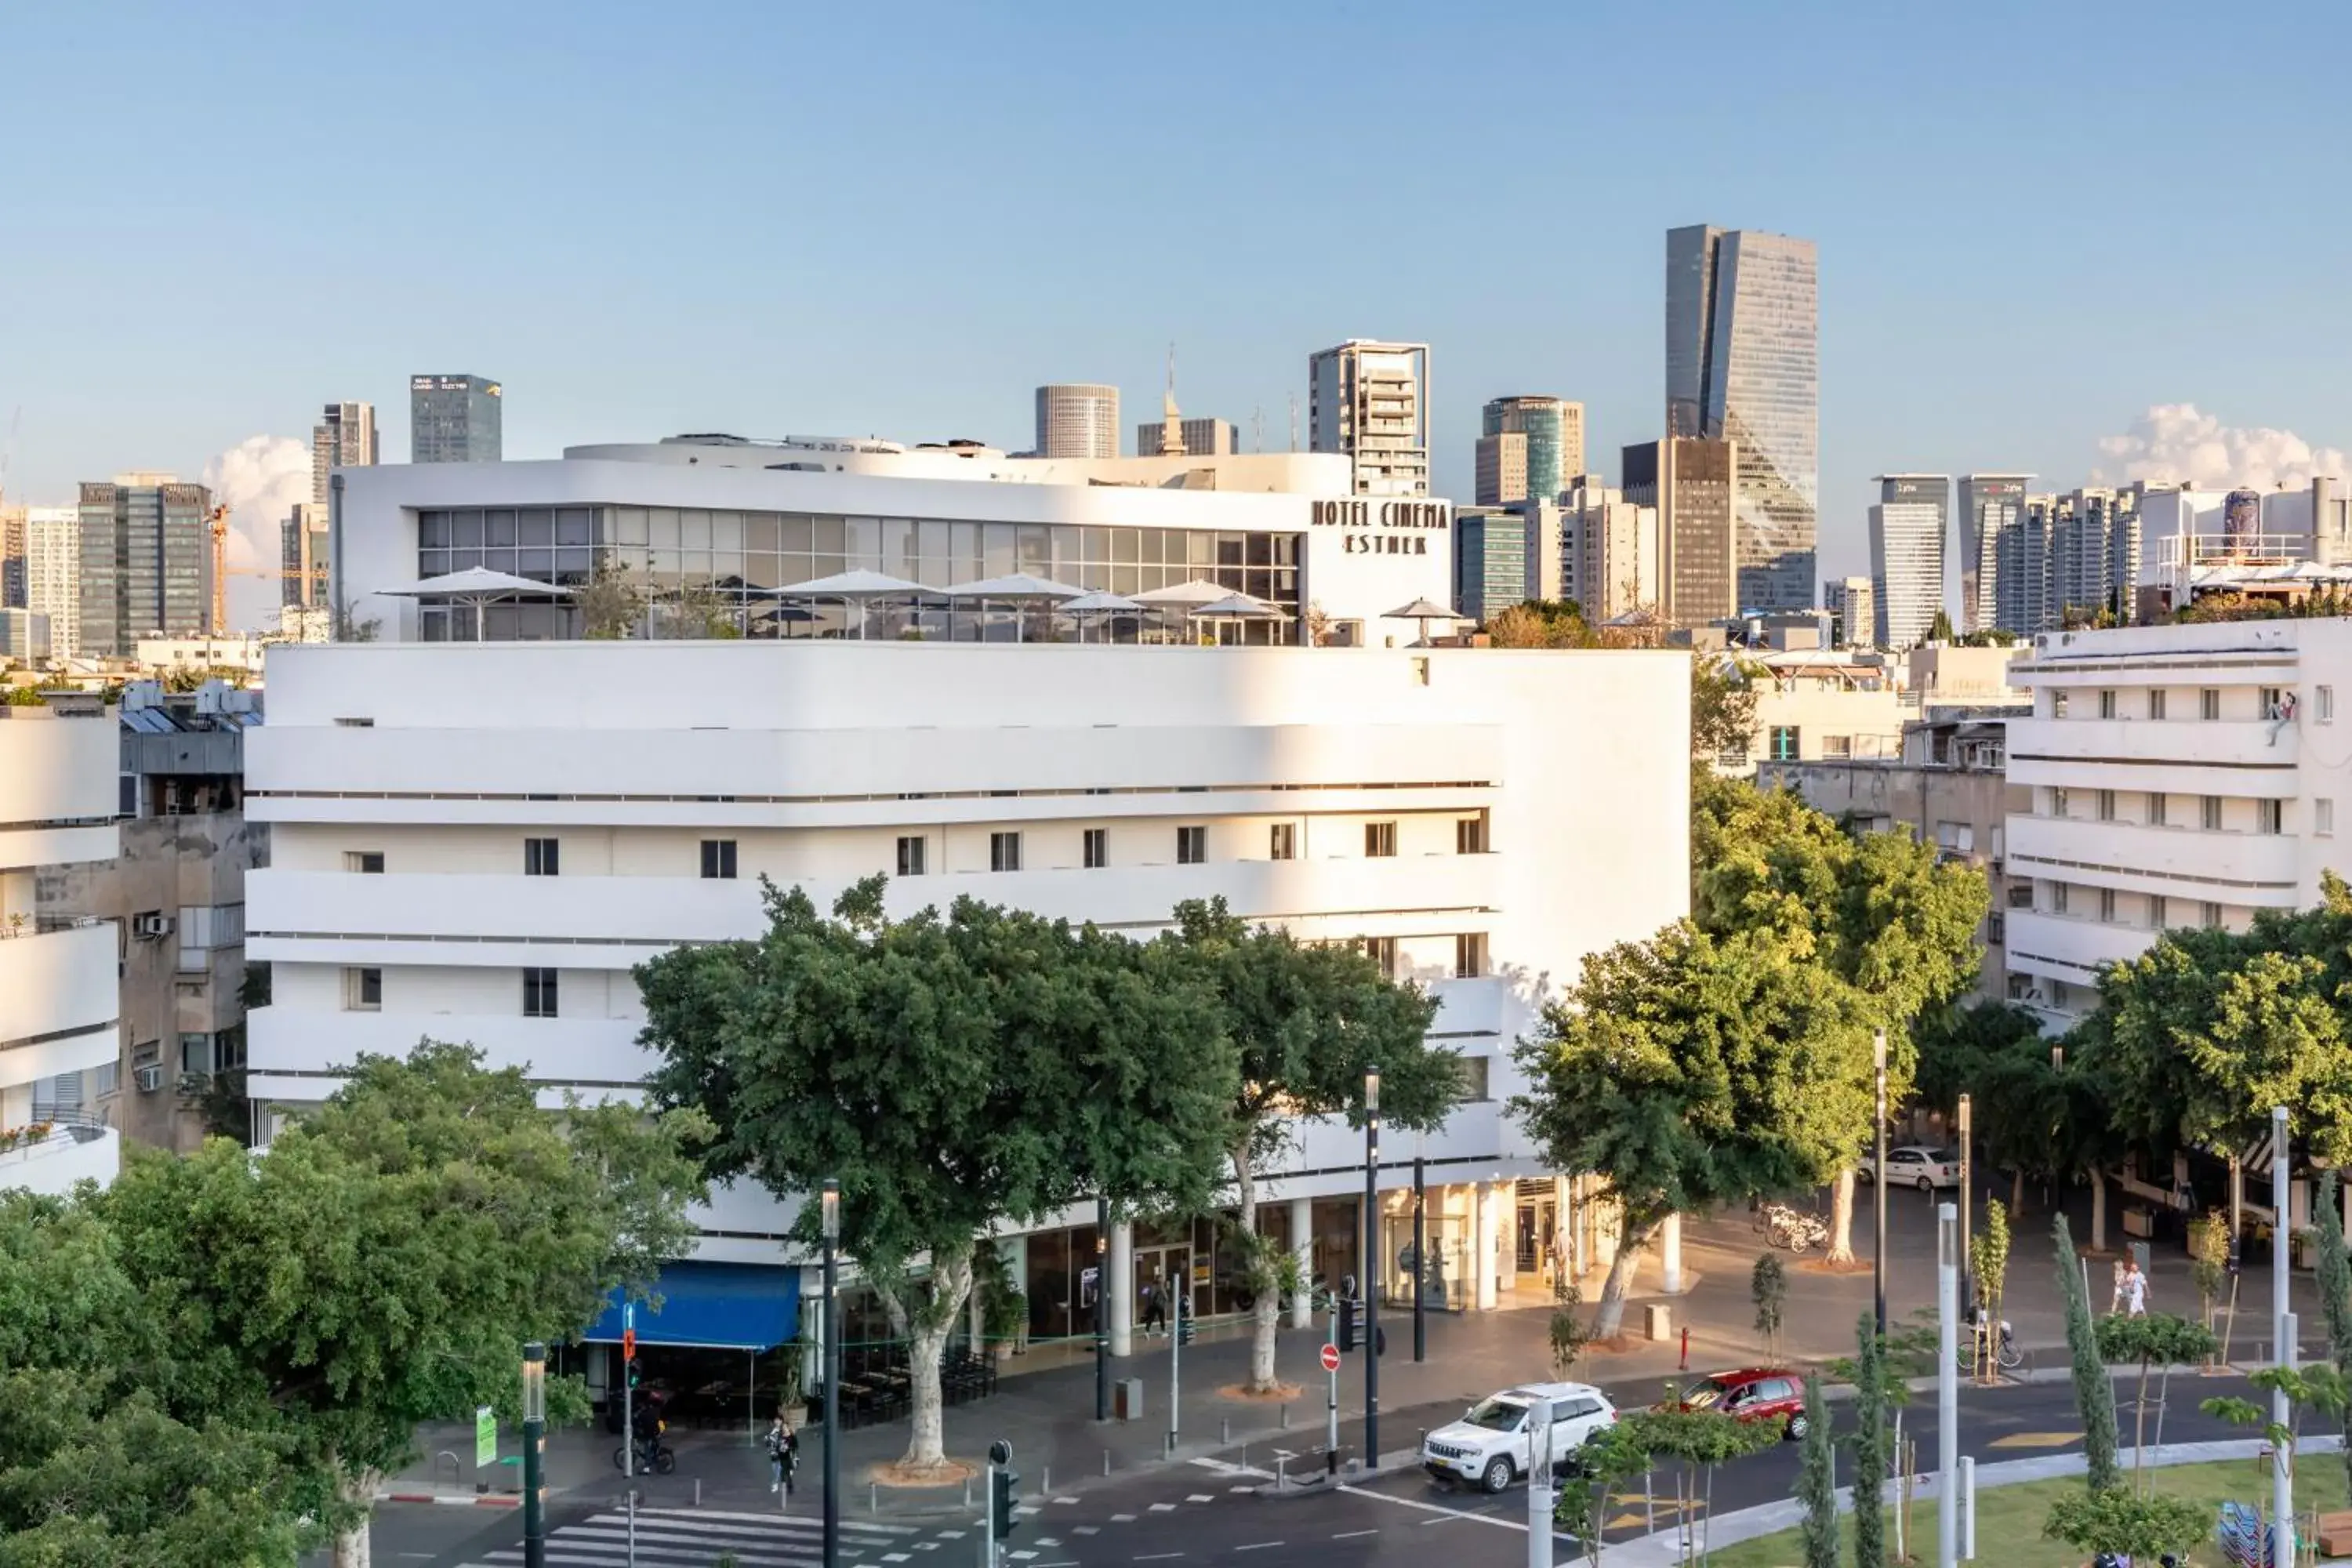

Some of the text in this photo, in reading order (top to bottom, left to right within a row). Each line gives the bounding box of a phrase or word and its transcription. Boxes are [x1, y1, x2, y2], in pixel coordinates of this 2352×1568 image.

[1311, 500, 1448, 528] HOTEL CINEMA
[1345, 534, 1427, 555] ESTHER
